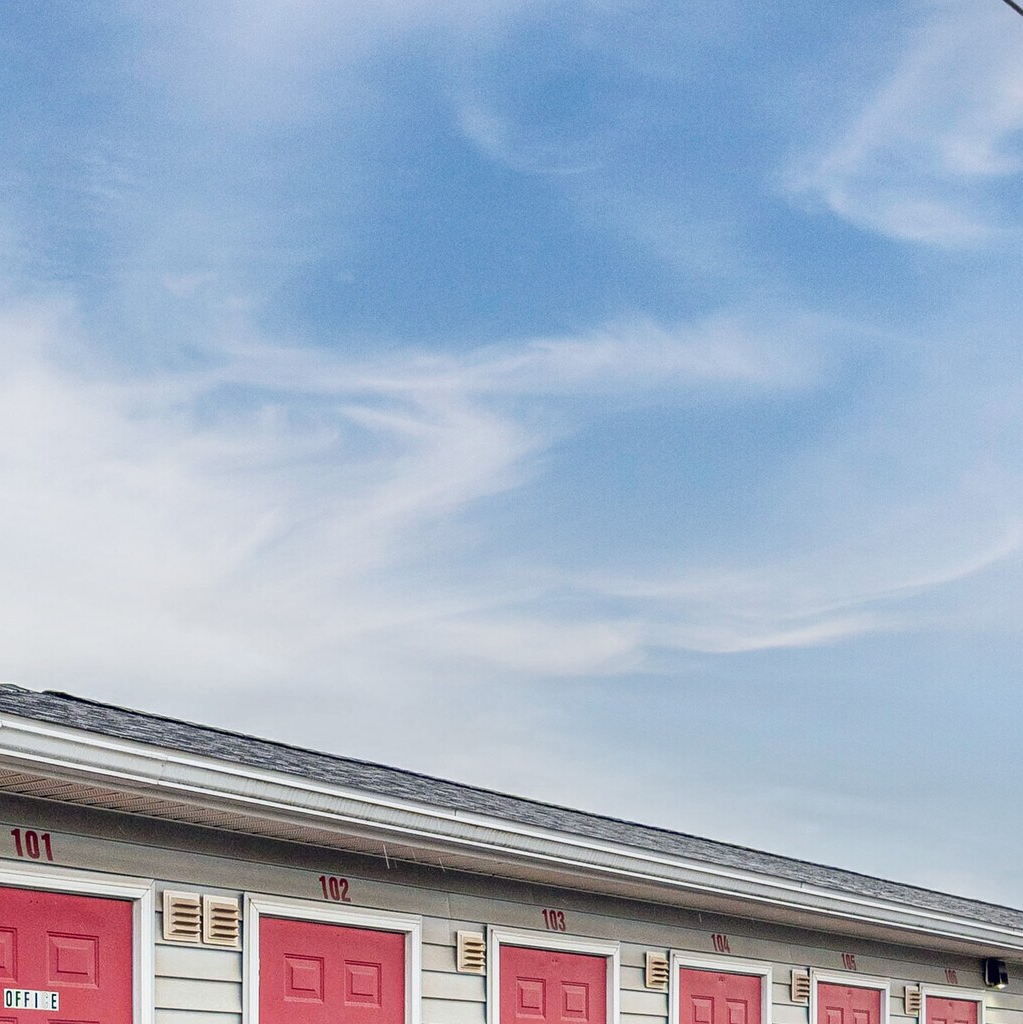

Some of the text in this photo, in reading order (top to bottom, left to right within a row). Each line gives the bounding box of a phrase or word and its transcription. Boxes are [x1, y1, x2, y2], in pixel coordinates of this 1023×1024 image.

[10, 828, 53, 861] 101
[319, 875, 351, 902] 102
[542, 909, 566, 931] 103
[711, 933, 730, 953] 104
